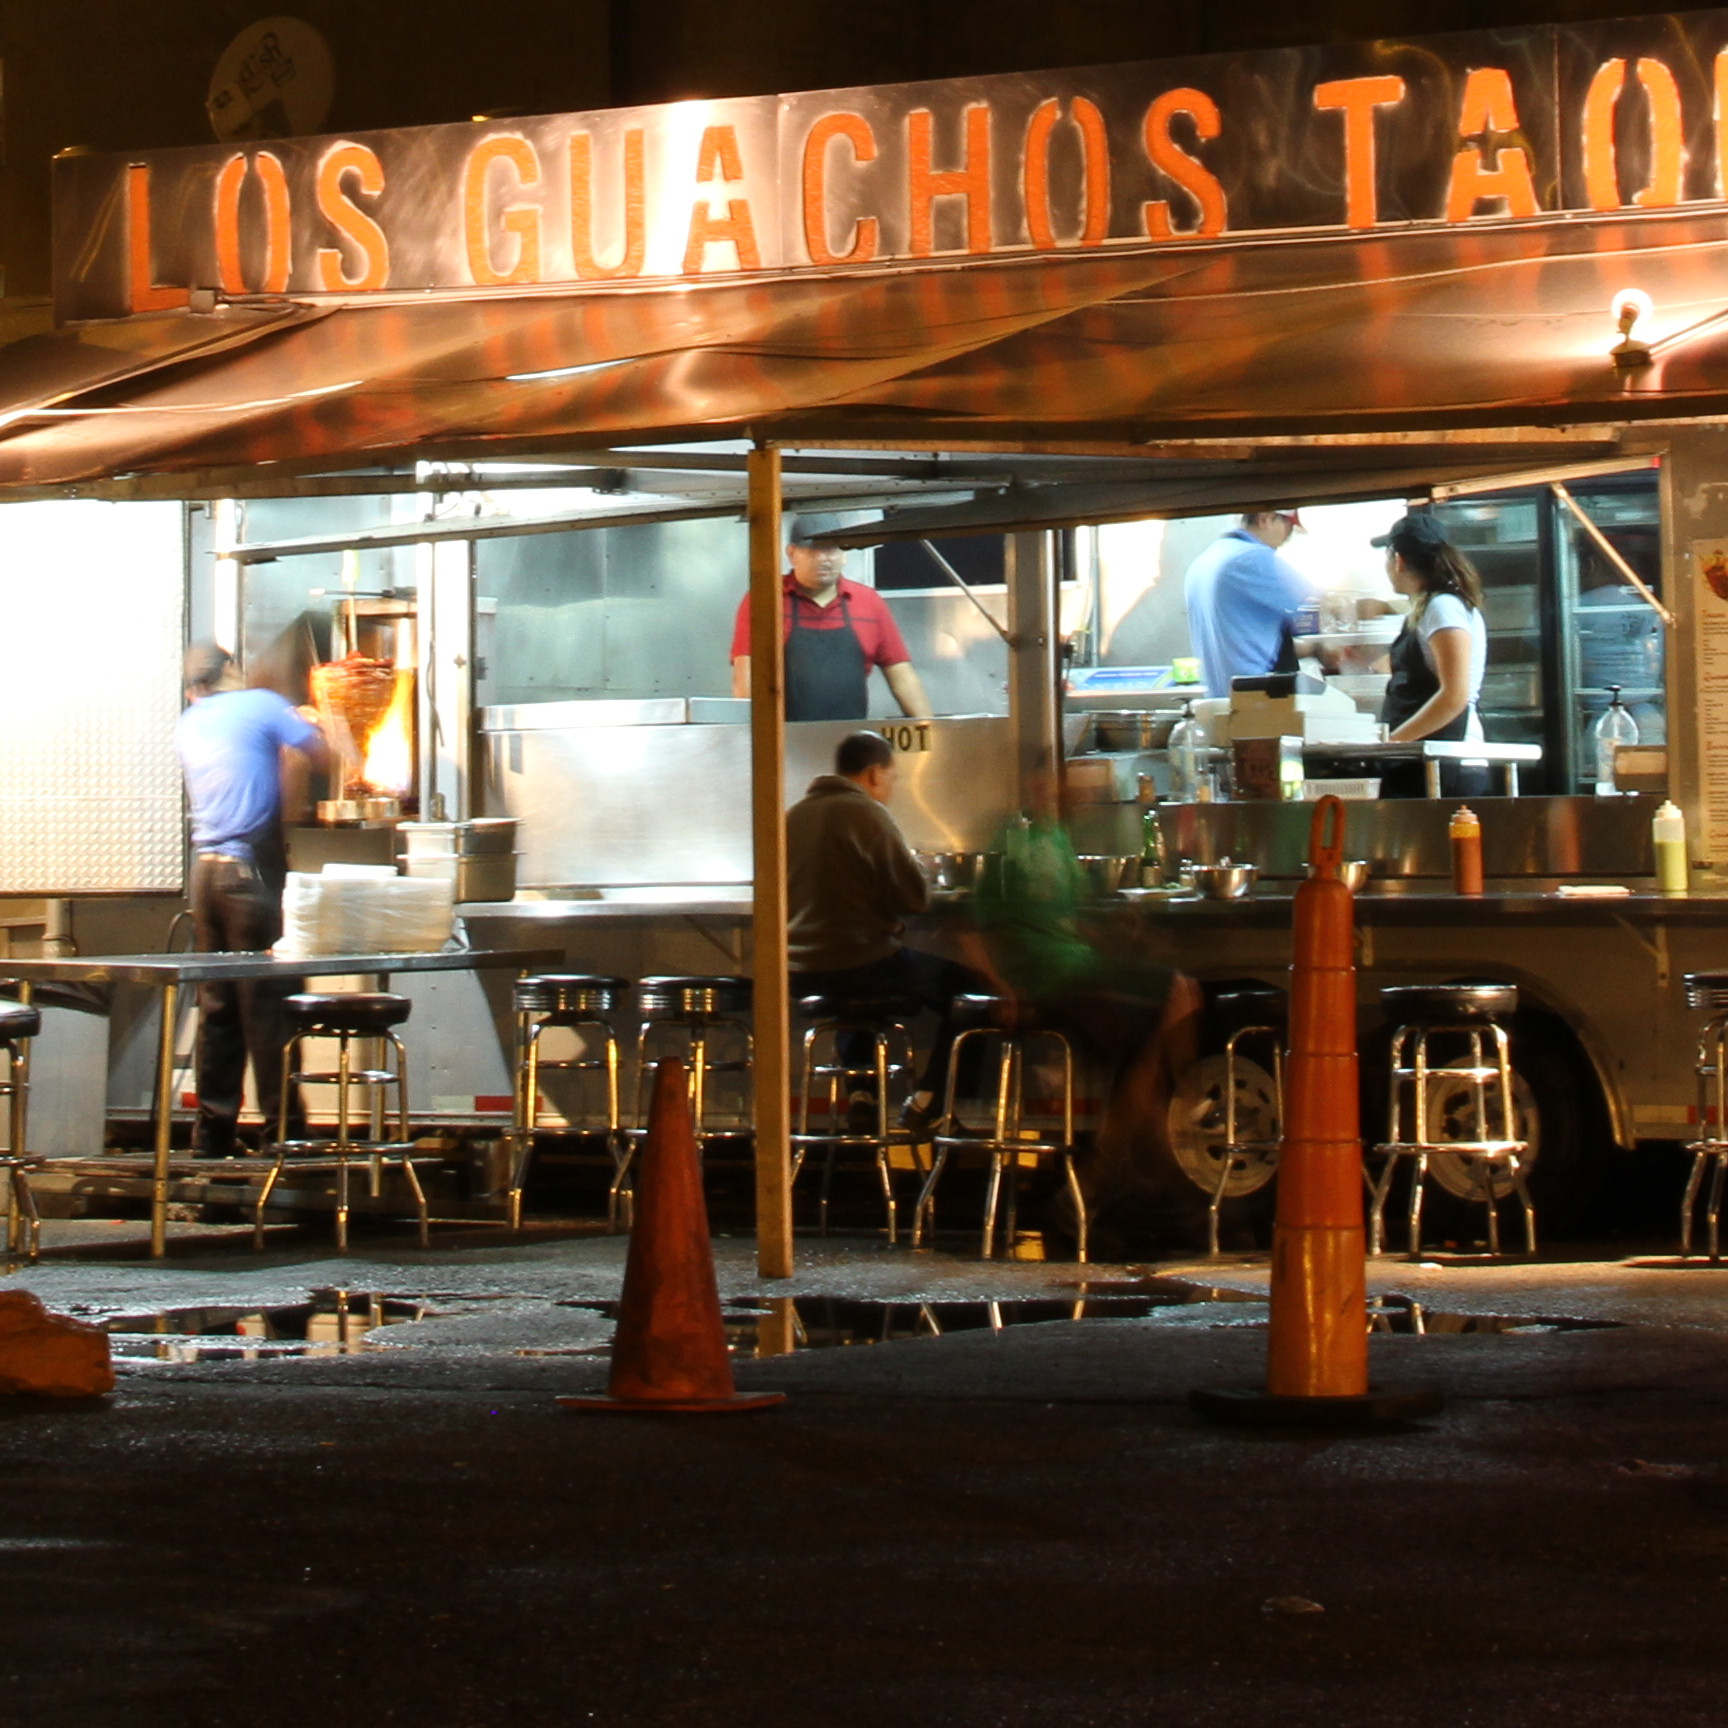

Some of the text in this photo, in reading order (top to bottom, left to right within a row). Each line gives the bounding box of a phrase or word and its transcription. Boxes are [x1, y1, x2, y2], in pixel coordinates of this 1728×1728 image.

[124, 140, 392, 316] LOS
[462, 86, 1227, 290] GUACHOS
[880, 724, 930, 752] HOT
